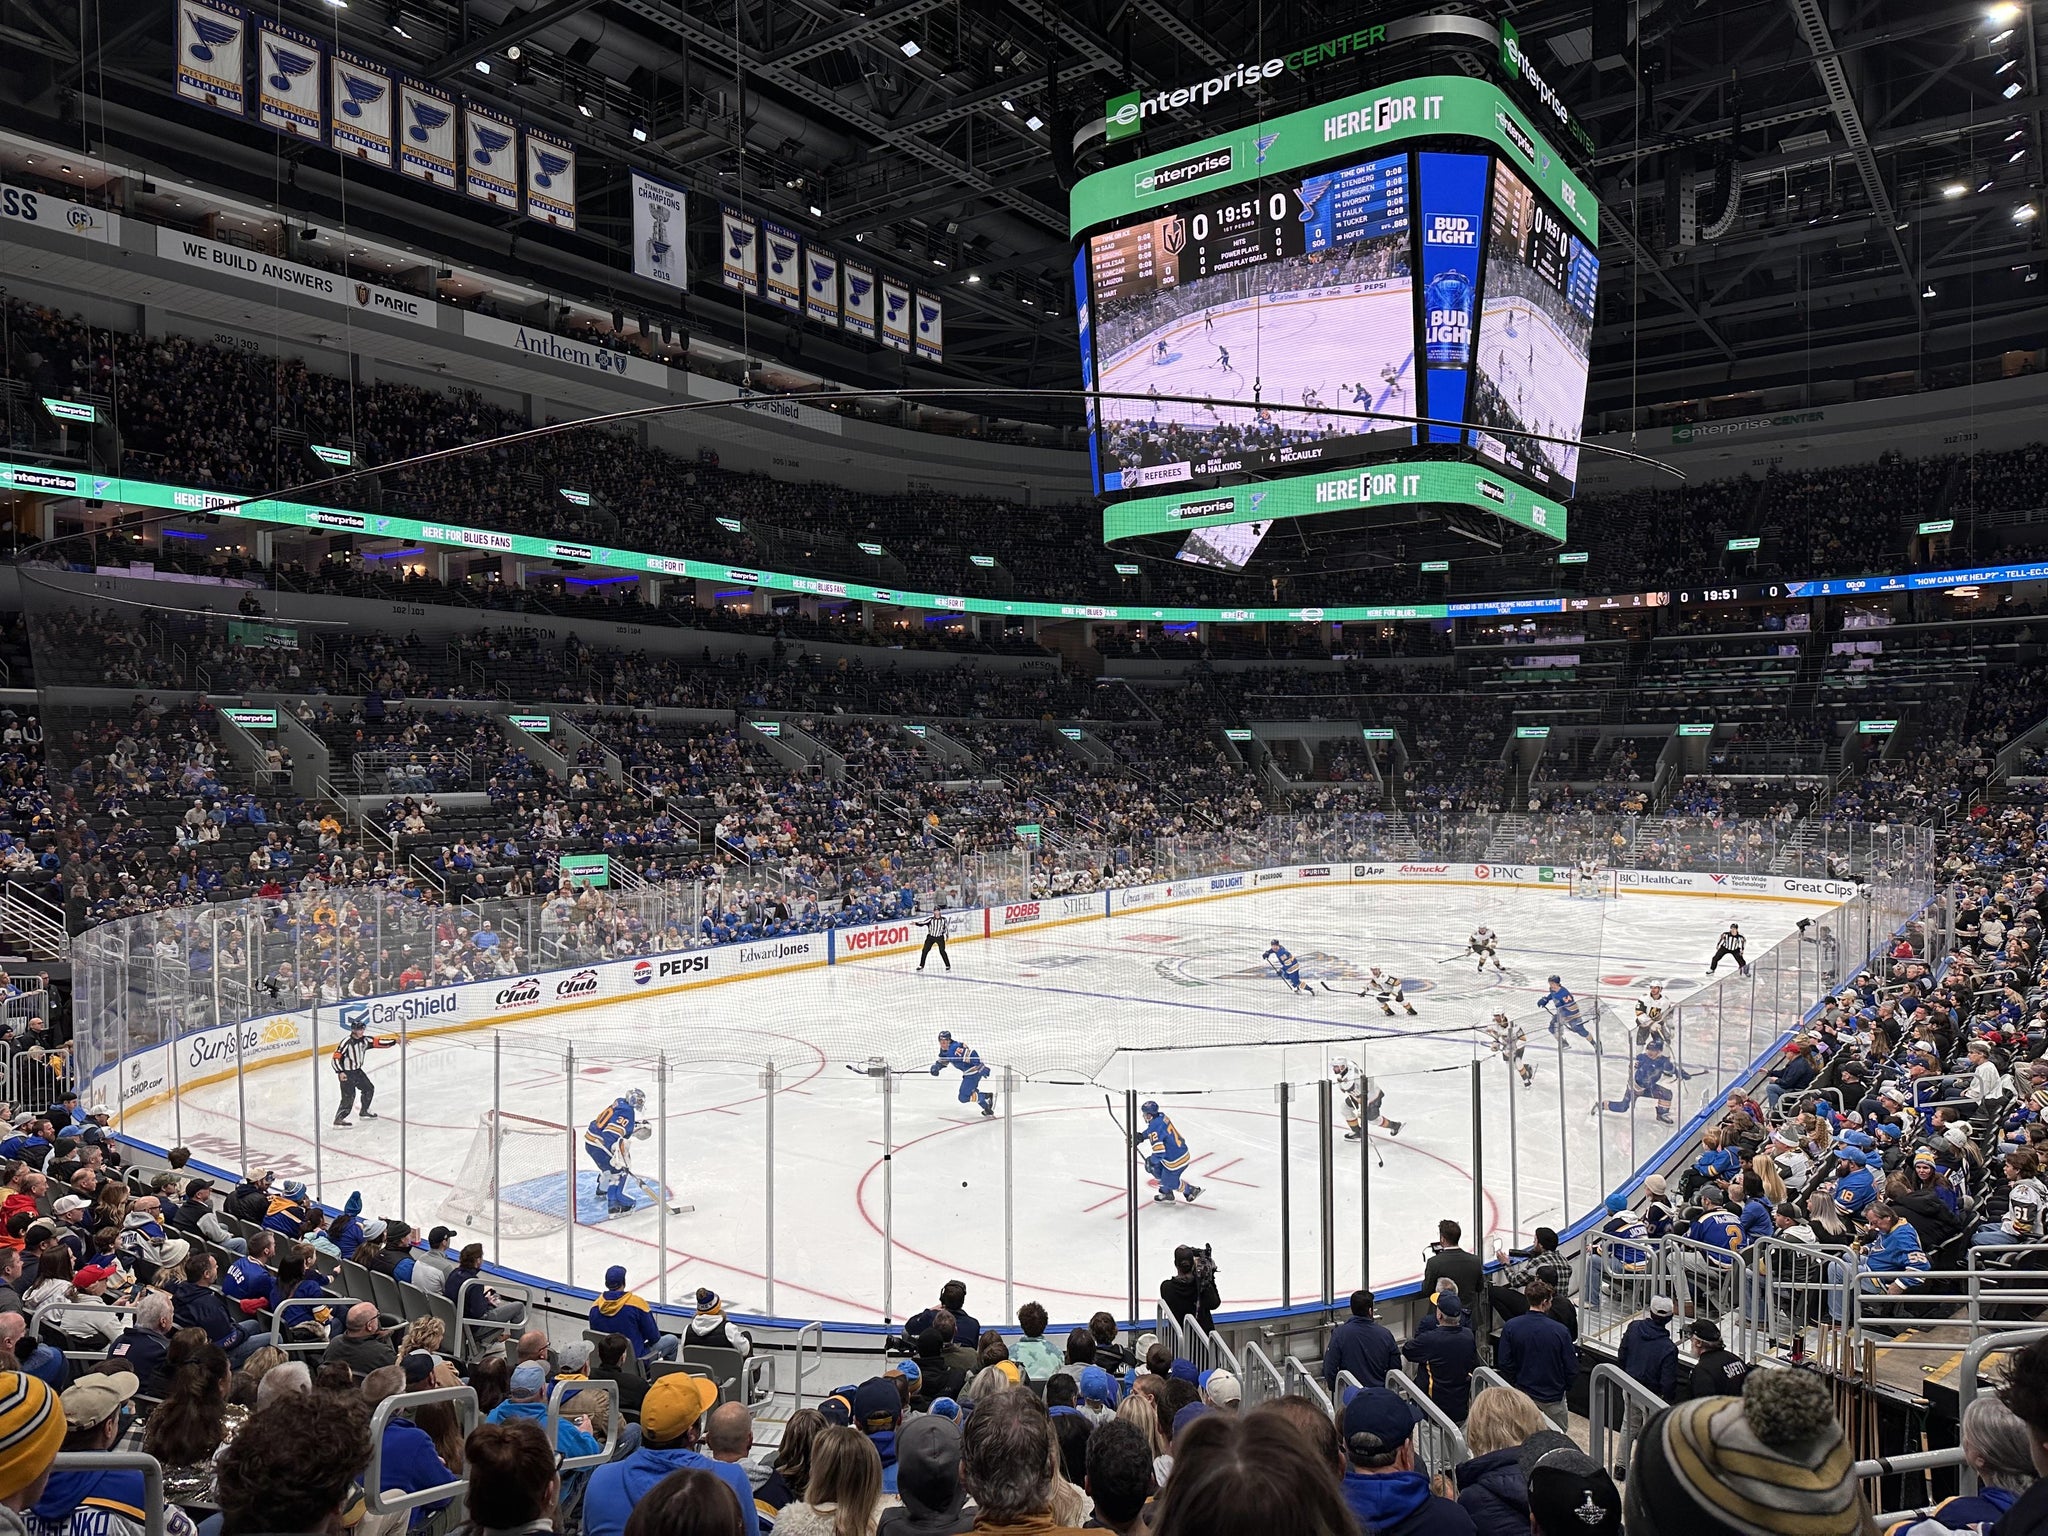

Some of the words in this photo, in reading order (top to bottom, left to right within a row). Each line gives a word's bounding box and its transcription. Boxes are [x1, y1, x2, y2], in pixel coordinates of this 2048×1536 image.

[182, 68, 202, 79] WEST
[207, 75, 241, 92] DIVISION
[1106, 56, 1284, 125] enterprise
[1285, 24, 1387, 71] CENTER
[182, 76, 241, 101] CHAMPIONS
[1504, 37, 1568, 125] enterprise
[1568, 117, 1596, 159] CENTER
[264, 96, 285, 108] WEST
[287, 104, 318, 119] DIVISION
[264, 104, 318, 128] CHAMPIONS
[1324, 106, 1372, 142] HERE
[1374, 97, 1416, 134] FOR
[1424, 95, 1444, 121] IT
[336, 129, 389, 153] CHAMPIONS
[361, 130, 388, 145] DIVISION
[1496, 112, 1535, 159] enterprise
[405, 154, 454, 176] CHAMPIONS
[1136, 154, 1231, 190] enterprise
[1341, 169, 1355, 178] TIME
[1356, 166, 1365, 174] ON
[1386, 167, 1402, 176] 0:08
[470, 176, 515, 197] CHAMPIONS
[1342, 174, 1375, 188] STENBERG
[644, 182, 665, 195] STANLEY
[665, 189, 675, 198] CUP
[1342, 184, 1375, 198] BERGGREN
[1386, 187, 1403, 196] 0:08
[638, 187, 681, 211] CHAMPIONS
[1270, 193, 1286, 220] 0
[1342, 195, 1370, 207] DVORSKY
[1387, 197, 1403, 206] 0:08
[531, 199, 574, 217] CHAMPIONS
[1216, 199, 1260, 225] 19:51
[1343, 207, 1363, 217] FAULK
[1387, 207, 1403, 216] 0:08
[1192, 213, 1208, 240] 0
[1235, 220, 1255, 231] PERIOD
[1343, 215, 1368, 226] TUCKER
[1434, 217, 1469, 231] BUD
[1535, 206, 1543, 234] 0
[1344, 229, 1364, 239] HOFER
[1544, 214, 1560, 242] 19:51
[1233, 238, 1246, 247] HITS
[1312, 239, 1325, 247] SOG
[1428, 230, 1475, 244] LIGHT
[1560, 232, 1568, 257] 0
[1221, 249, 1242, 259] POWER
[1242, 245, 1260, 256] PLAYS
[183, 241, 208, 260] WE
[212, 250, 257, 273] BUILD
[262, 263, 333, 294] ANSWERS
[1214, 260, 1233, 272] POWER
[1233, 257, 1248, 268] PLAY
[1248, 252, 1267, 264] GOALS
[653, 268, 670, 281] 2019
[1104, 289, 1117, 298] HART
[374, 293, 418, 316] PARIC
[1430, 310, 1469, 327] BUD
[214, 333, 233, 346] 302
[240, 338, 259, 351] 303
[514, 327, 590, 367] Anthem
[1672, 419, 1770, 441] enterprise
[1771, 411, 1824, 426] CENTER
[1207, 458, 1221, 466] BEAU
[1269, 452, 1276, 463] 4
[1280, 448, 1323, 463] MCCAULEY
[1144, 467, 1182, 481] REFEREES
[1195, 463, 1206, 474] 48
[1207, 461, 1242, 474] HALKIDIS
[0, 470, 76, 488] enterprise
[1316, 478, 1358, 503] HERE
[1360, 473, 1396, 502] FOR
[1403, 475, 1420, 496] IT
[174, 491, 201, 507] HERE
[1168, 501, 1234, 517] enterprise
[307, 513, 364, 528] enterprise
[422, 526, 444, 540] HERE
[446, 529, 461, 541] FOR
[464, 531, 489, 546] BLUES
[491, 535, 511, 548] FANS
[549, 546, 592, 557] enterprise
[664, 561, 676, 571] FOR
[677, 562, 685, 572] IT
[1846, 581, 1865, 589] 00:00
[1937, 576, 1955, 584] CAN
[1955, 574, 1969, 583] WE
[1969, 571, 1999, 581] HELP?"
[793, 579, 806, 588] HERE
[807, 580, 817, 589] FOR
[818, 582, 833, 592] BLUES
[834, 584, 846, 594] FANS
[1703, 588, 1738, 601] 19:51
[948, 598, 958, 608] FOR
[959, 599, 965, 608] IT
[1449, 602, 1471, 611] LEGEND
[1484, 601, 1499, 609] MAKE
[1087, 608, 1103, 617] BLUES
[1367, 609, 1382, 617] HERE
[1384, 609, 1395, 617] FOR
[1397, 609, 1416, 617] BLUES
[1260, 872, 1283, 881] UNDERDOG
[1305, 867, 1330, 876] PURINA
[1398, 864, 1449, 874] Schnucks
[1492, 866, 1524, 879] PNC
[1211, 878, 1225, 889] BUD
[1225, 876, 1243, 887] LIGHT
[1619, 874, 1636, 882] BJC
[1641, 875, 1692, 885] HealthCare
[1731, 879, 1767, 889] Technology
[1784, 879, 1823, 893] Great
[1825, 882, 1852, 896] Clips
[1122, 889, 1140, 907] Circa
[1005, 902, 1040, 919] DOBBS
[1063, 897, 1093, 915] STIFEL
[845, 924, 909, 950] verizon
[634, 969, 652, 977] PEPSI
[660, 956, 709, 977] PEPSI
[555, 989, 598, 1000] CARWASH
[556, 979, 598, 995] Club
[496, 987, 541, 1005] Club
[372, 992, 457, 1024] CarShield
[495, 999, 540, 1010] CARWASH
[616, 1115, 629, 1127] 30
[1842, 1190, 1854, 1201] 18
[2013, 1206, 2029, 1220] 61
[1725, 1225, 1743, 1251] 2
[1907, 1251, 1927, 1264] 55
[227, 1265, 245, 1285] BLUES
[1723, 1361, 1745, 1378] SAFETY
